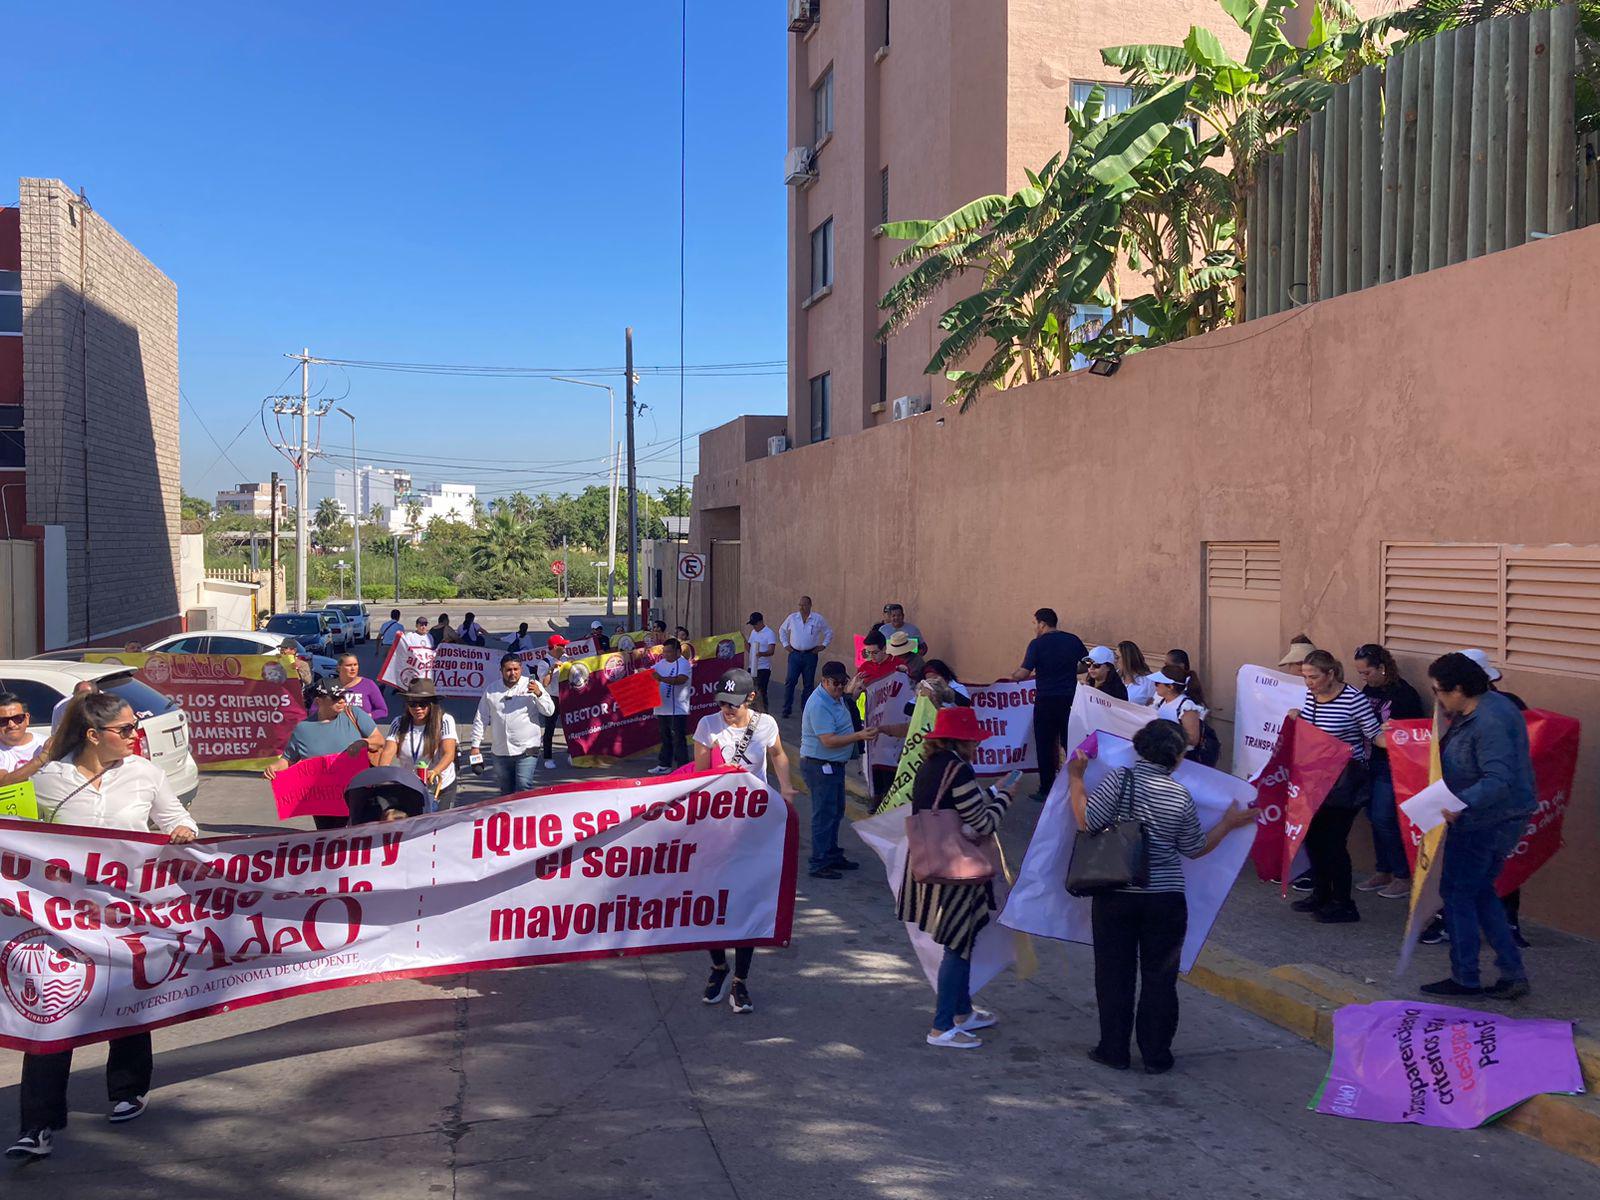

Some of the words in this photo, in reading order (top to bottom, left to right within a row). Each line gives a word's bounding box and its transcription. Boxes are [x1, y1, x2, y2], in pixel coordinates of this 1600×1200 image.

[686, 560, 697, 573] E
[437, 647, 482, 660] posición
[169, 655, 242, 679] UAdeO
[188, 694, 216, 707] LOS
[220, 694, 291, 707] CRITERIOS
[970, 688, 1038, 710] respete
[215, 711, 230, 724] SE
[233, 708, 284, 724] UNGIÓ
[565, 702, 609, 725] RECTOR
[256, 726, 267, 739] A
[978, 717, 1008, 736] ntir
[1244, 735, 1278, 752] TRANSPA
[471, 812, 563, 860] ¡Que
[573, 807, 620, 844] se
[630, 785, 769, 825] respete
[44, 857, 72, 884] a
[84, 852, 129, 893] la
[139, 836, 374, 894] imposición
[381, 831, 404, 867] y
[581, 839, 697, 880] sentir
[44, 885, 263, 931] cacicazgo
[488, 889, 730, 942] mayoritario!
[116, 896, 364, 991] UAdeO
[115, 984, 201, 1017] UNIVERSIDAD
[274, 963, 291, 976] DE
[292, 951, 361, 973] OCCIDENTE
[1474, 1026, 1499, 1069] Pedro
[1421, 1035, 1455, 1105] criterios
